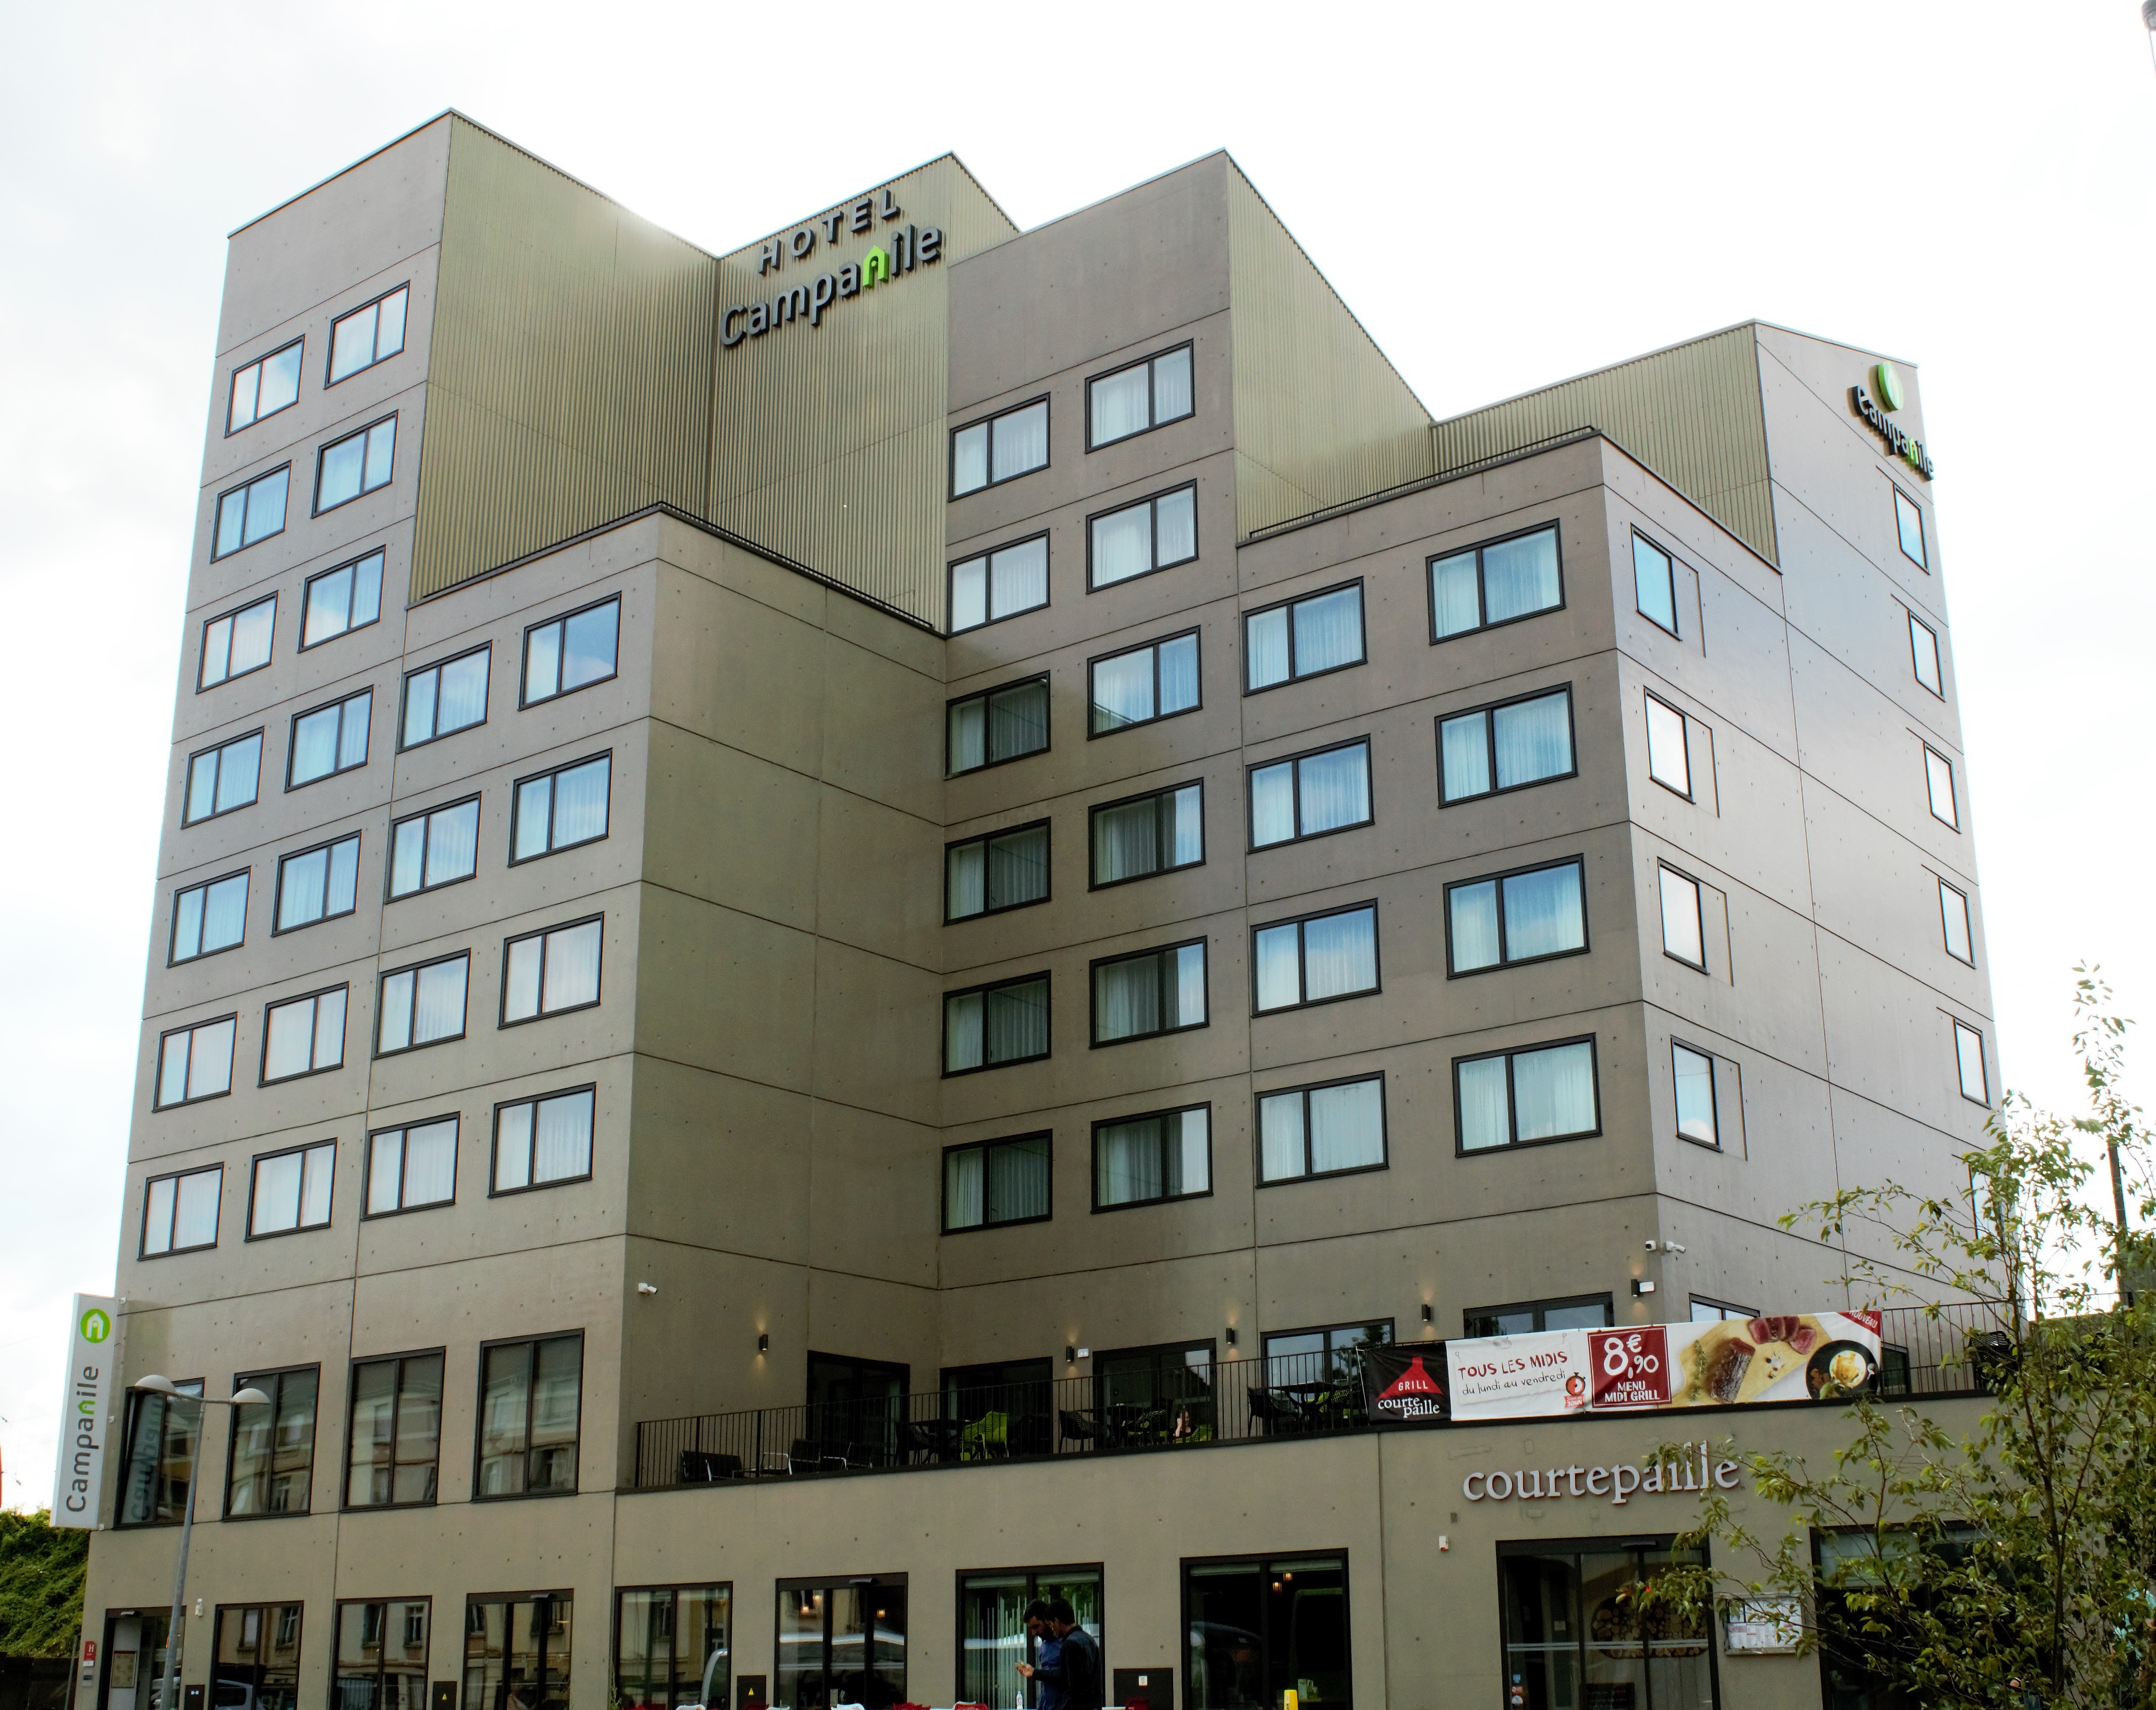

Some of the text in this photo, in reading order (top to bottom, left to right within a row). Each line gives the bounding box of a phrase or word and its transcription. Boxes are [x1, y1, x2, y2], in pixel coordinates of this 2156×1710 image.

[757, 189, 901, 275] HOTEL
[720, 224, 942, 346] Campanile
[1458, 1351, 1568, 1380] TOUS LES MIDIS
[1398, 1380, 1428, 1391] GRILL
[1462, 1384, 1475, 1395] du
[1478, 1379, 1501, 1394] lundi
[1521, 1368, 1566, 1386] vendredi
[1617, 1380, 1646, 1392] MENU
[1378, 1397, 1420, 1410] courte
[1403, 1399, 1440, 1418] paille
[1604, 1389, 1660, 1403] MIDI GRILL
[66, 1366, 99, 1512] Campanile
[1463, 1440, 1739, 1505] courtepaille
